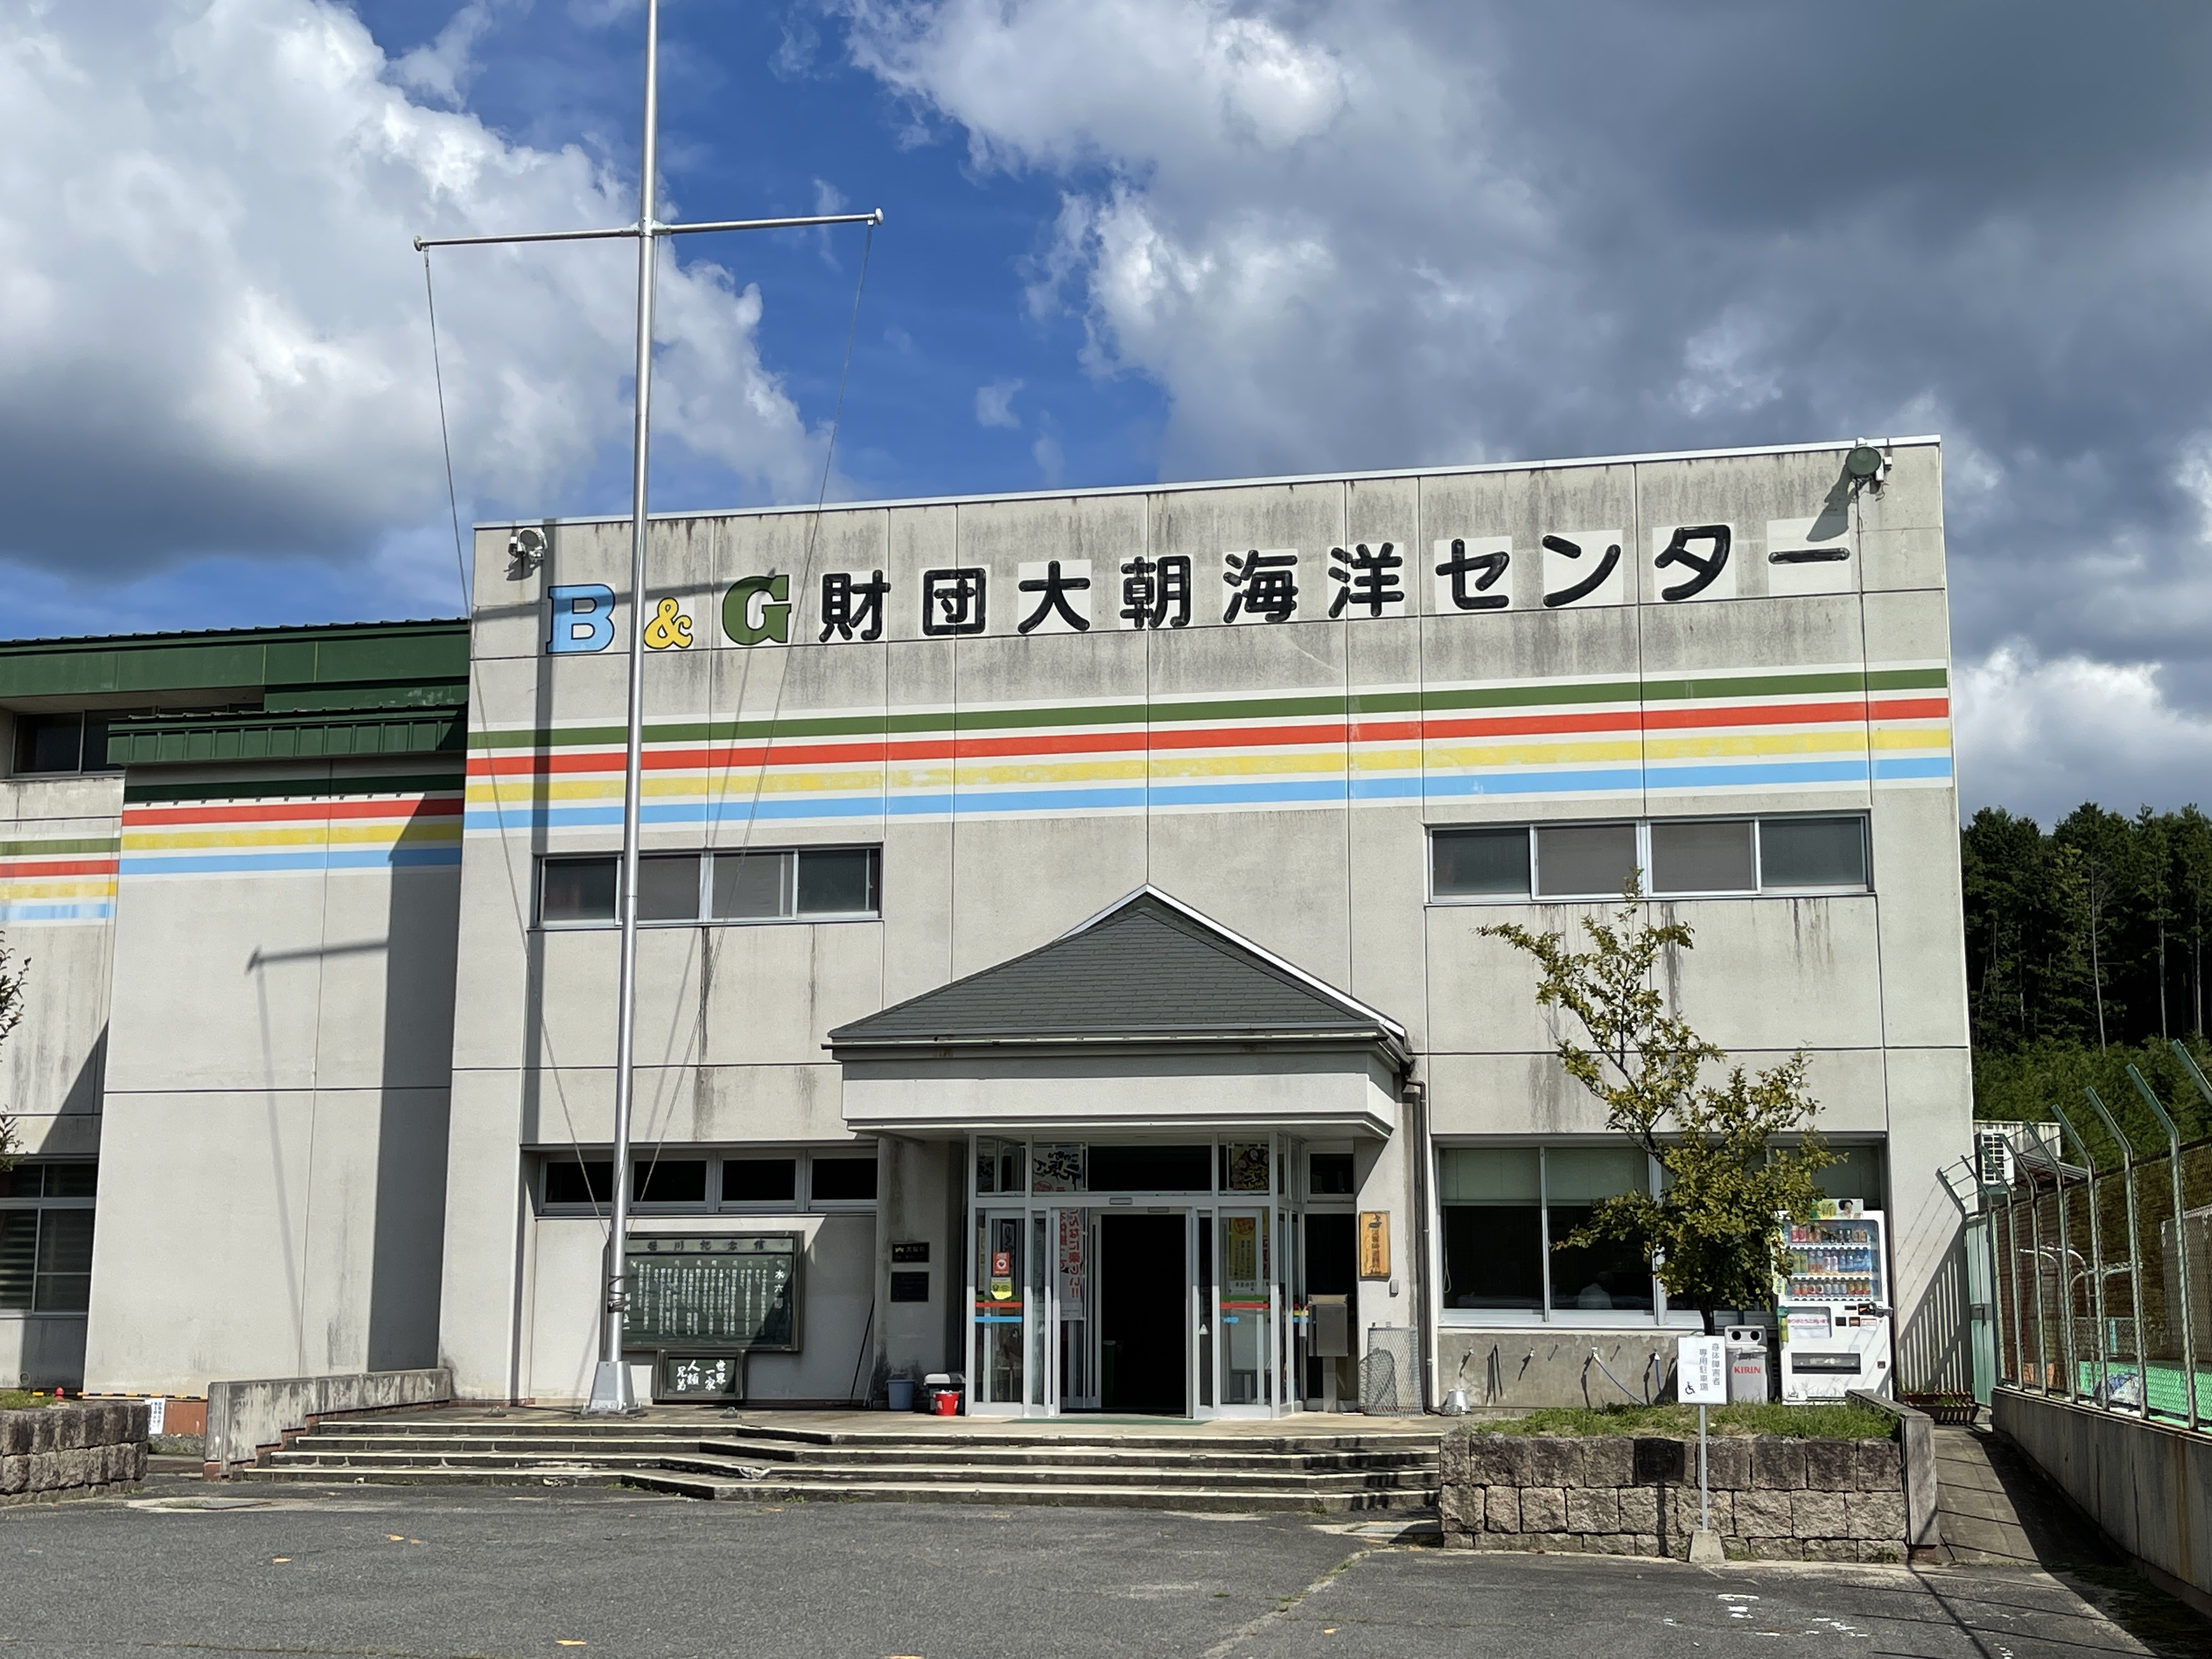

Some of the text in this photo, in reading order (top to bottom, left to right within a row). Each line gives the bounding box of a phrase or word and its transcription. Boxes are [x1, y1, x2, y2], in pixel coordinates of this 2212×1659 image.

[819, 525, 1850, 642] 財団大朝海洋センター
